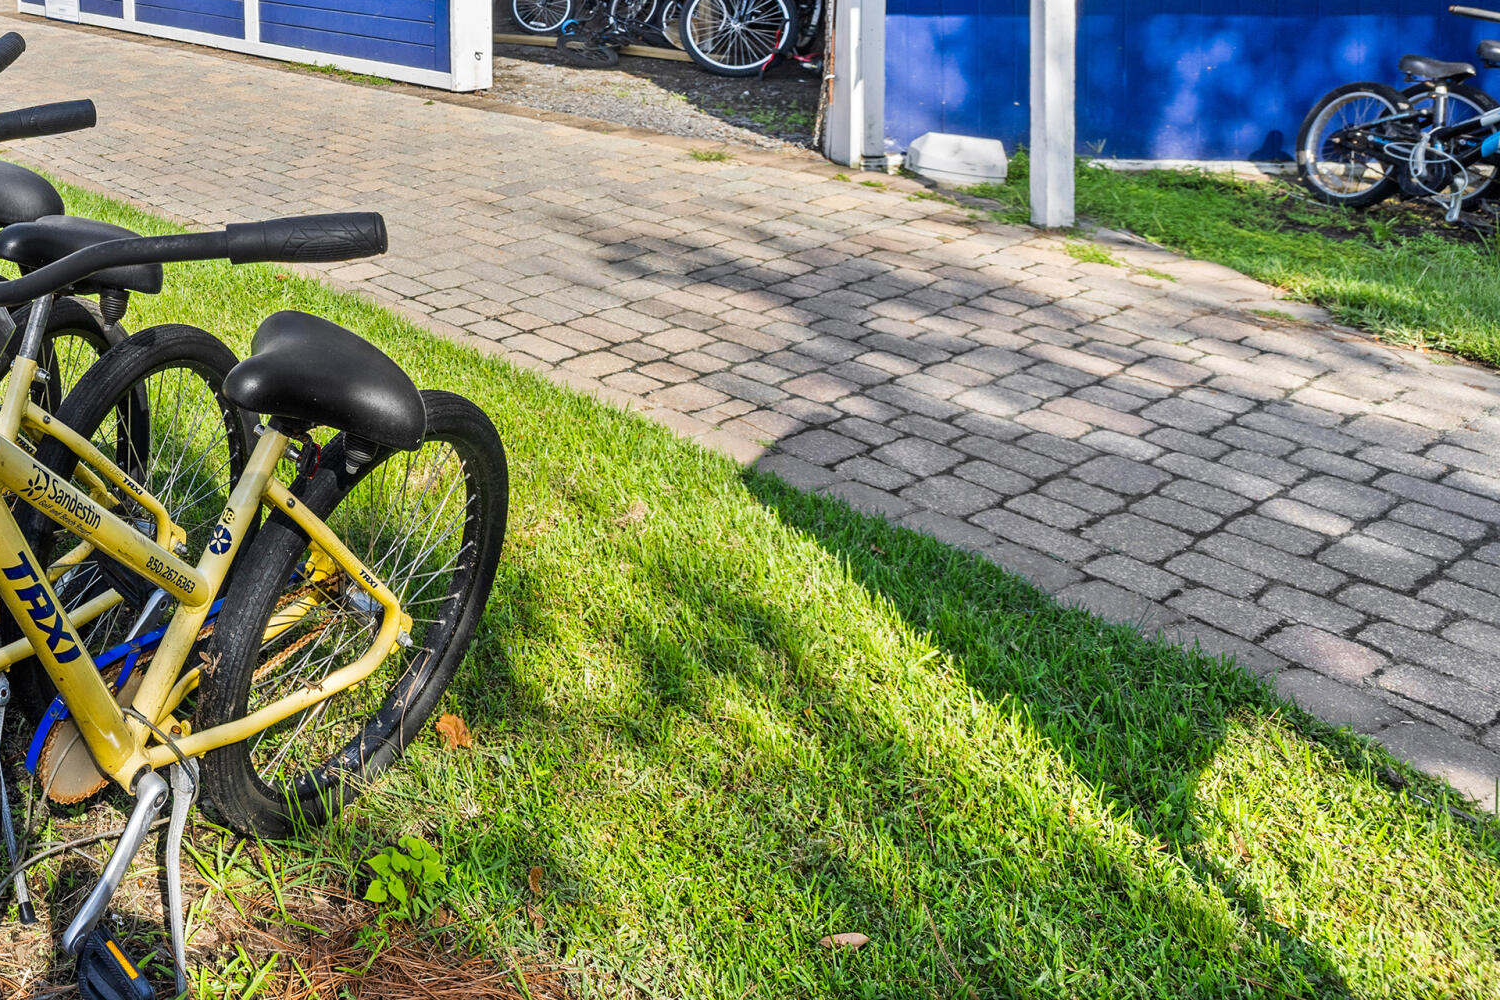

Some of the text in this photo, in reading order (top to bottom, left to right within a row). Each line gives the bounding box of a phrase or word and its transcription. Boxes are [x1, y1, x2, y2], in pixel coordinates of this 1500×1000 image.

[122, 476, 144, 497] TAXI
[47, 478, 101, 531] Sandestin
[50, 508, 59, 518] and
[146, 556, 196, 595] 850.267.6363
[359, 569, 378, 588] TAXI
[2, 551, 82, 665] TAXI
